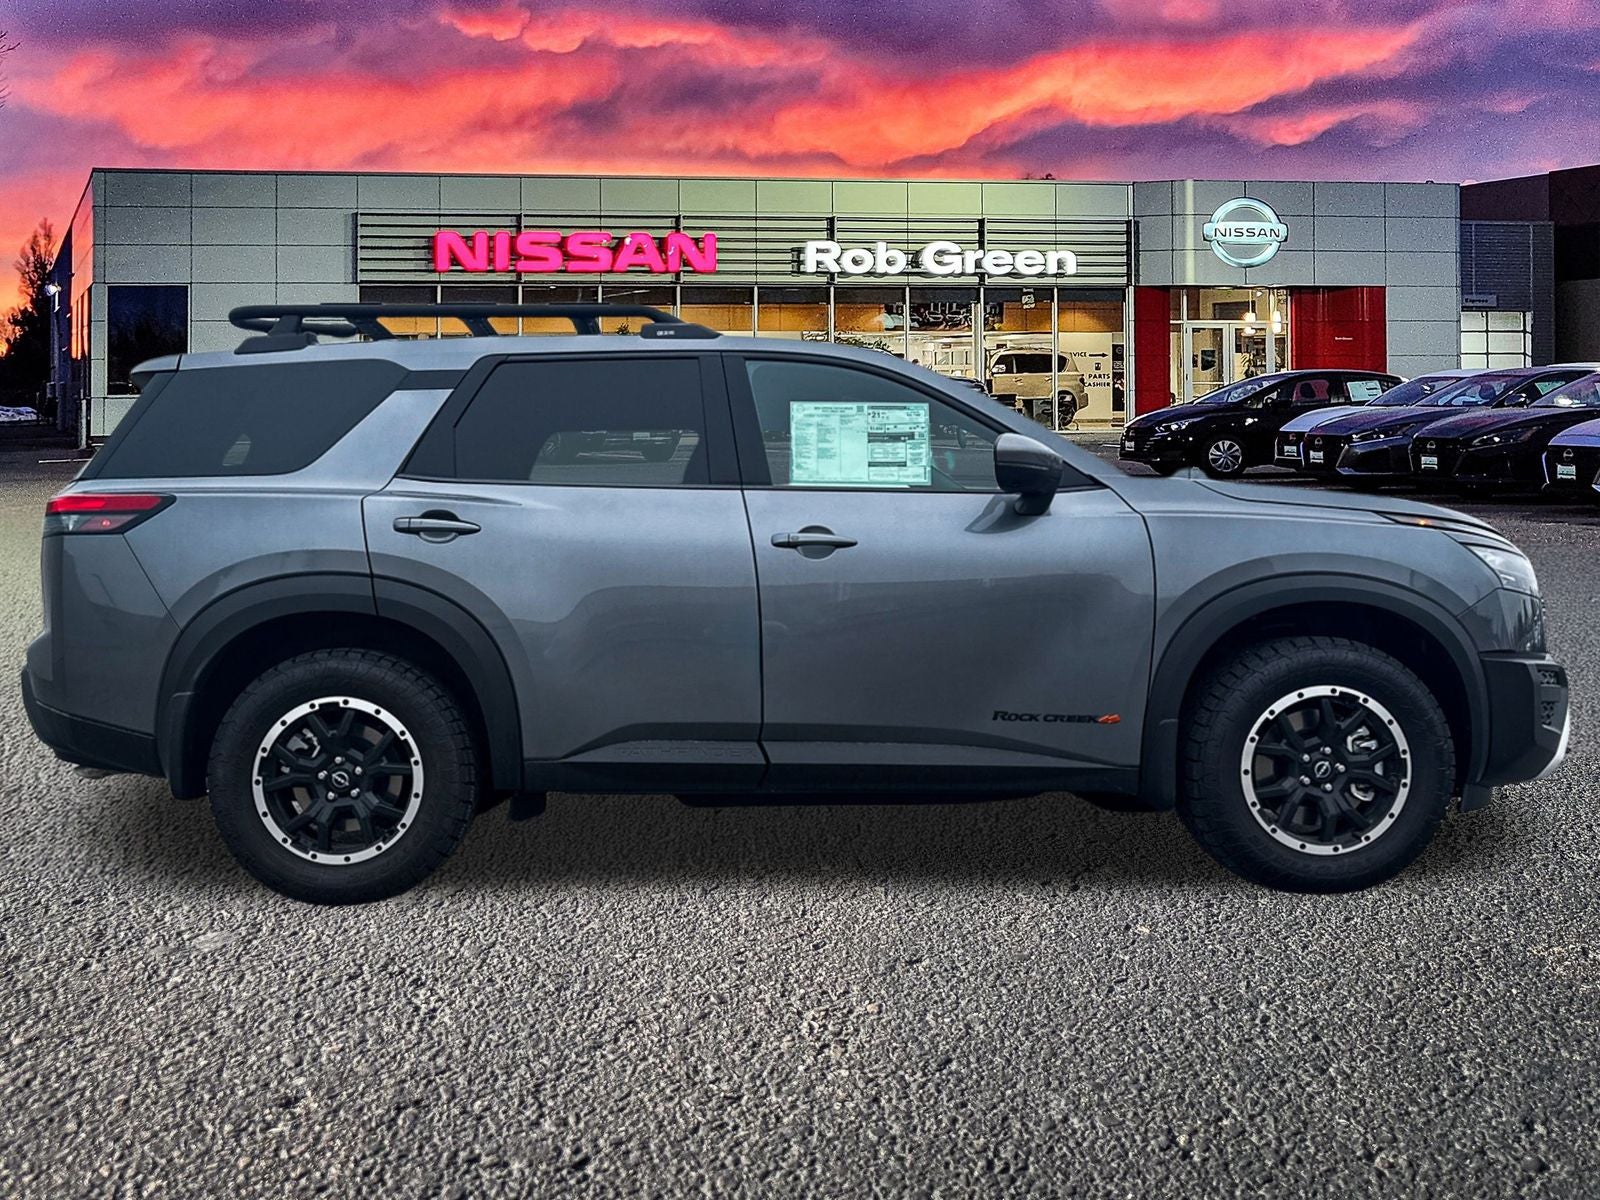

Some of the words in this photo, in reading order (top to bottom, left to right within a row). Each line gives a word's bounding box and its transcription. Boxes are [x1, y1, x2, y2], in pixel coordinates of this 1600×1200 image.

[1214, 227, 1280, 238] NISSAN
[433, 229, 718, 273] NISSAN
[804, 240, 907, 275] Rob
[922, 240, 1078, 276] Green
[992, 710, 1041, 722] ROCK
[1043, 713, 1099, 724] CREEK
